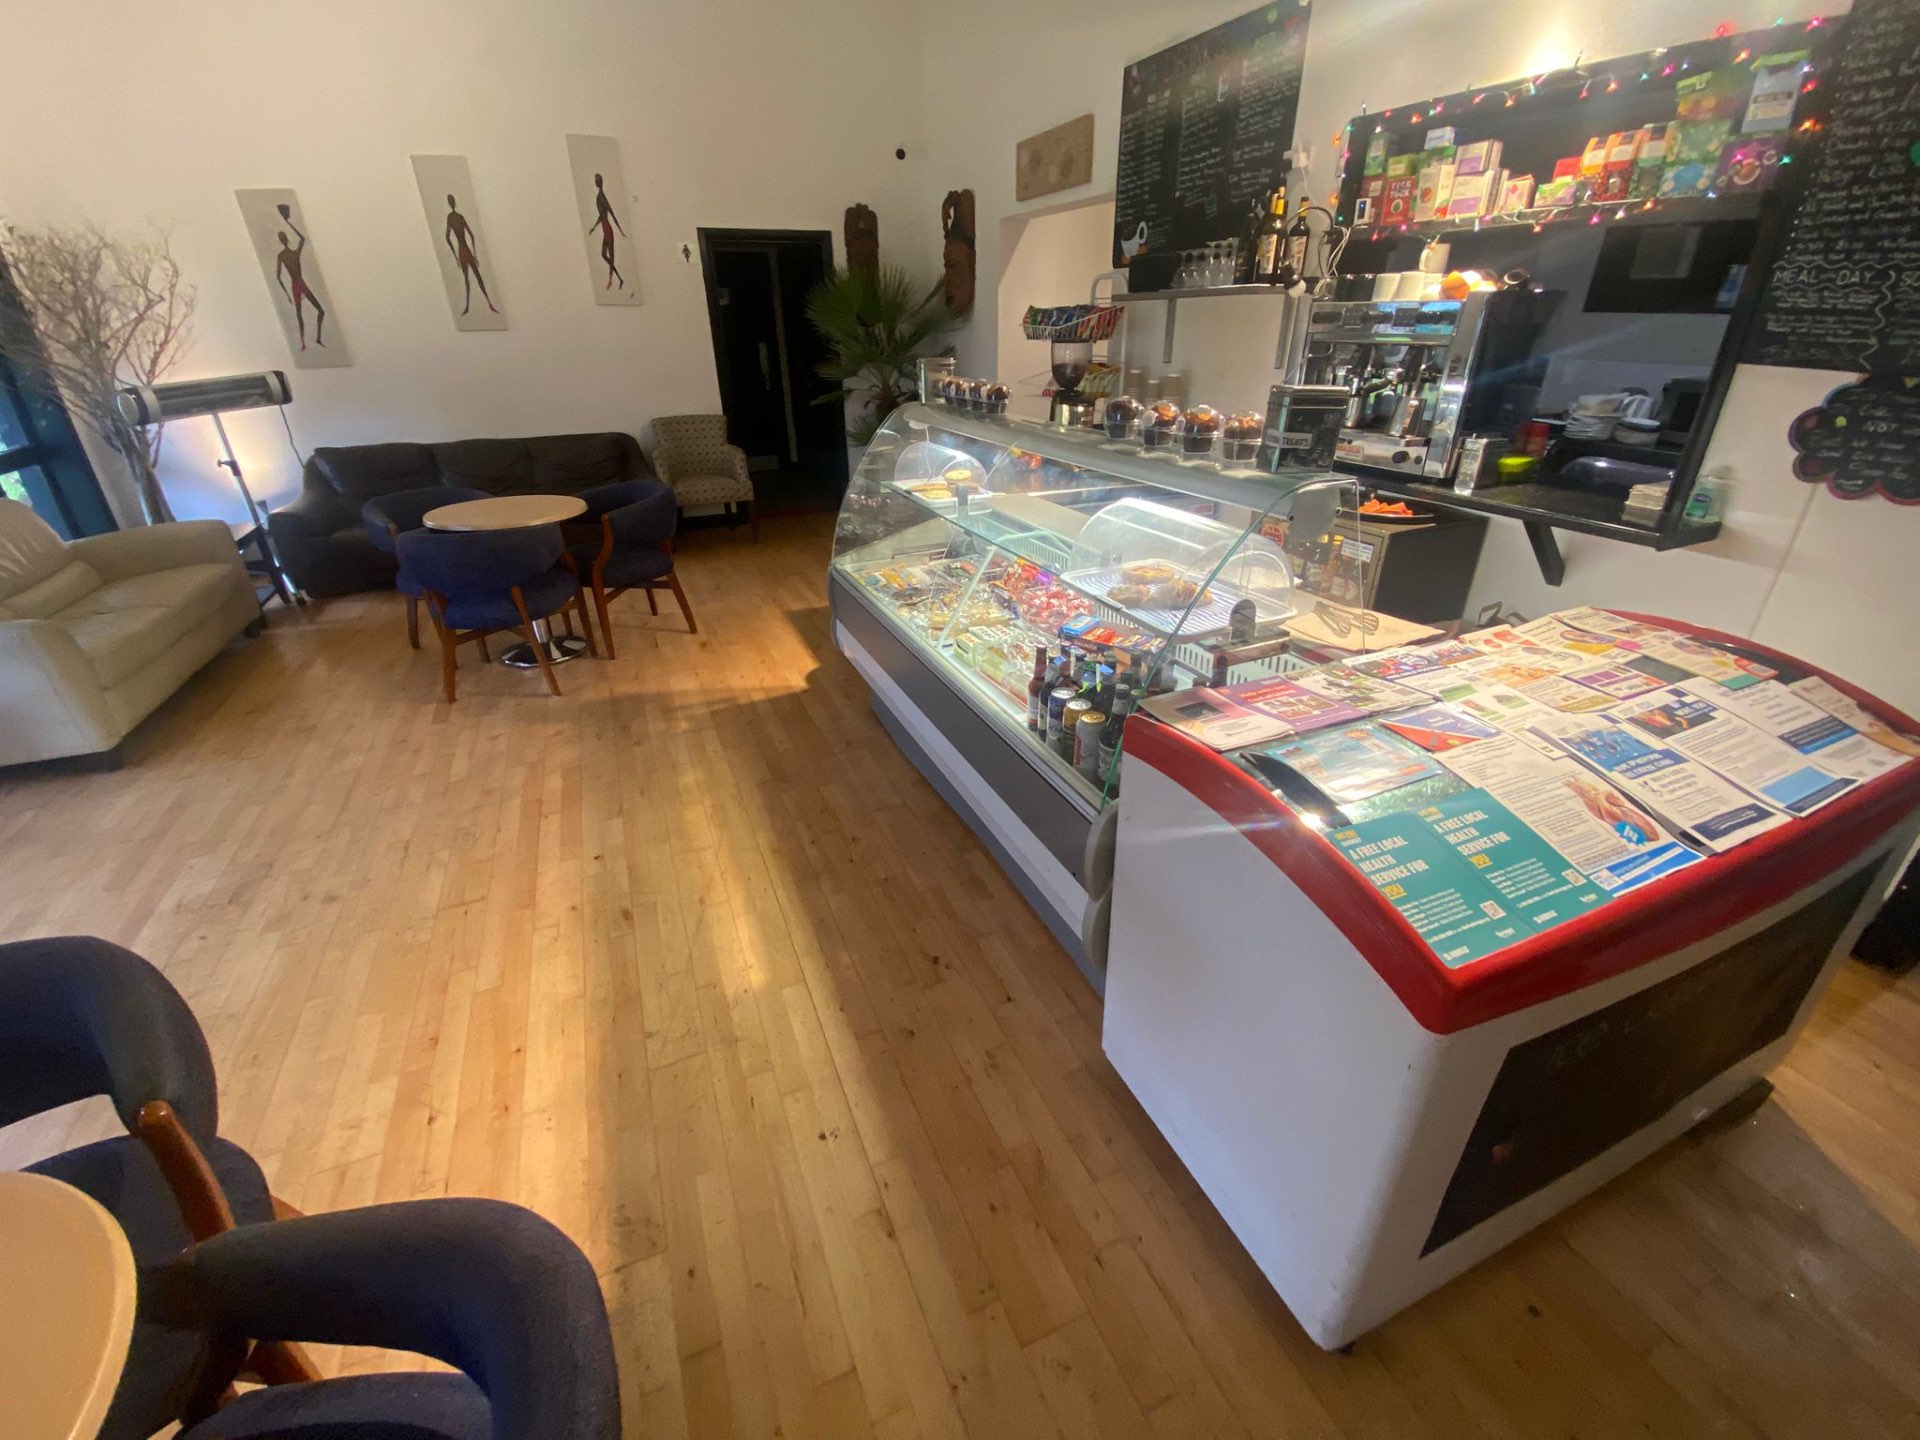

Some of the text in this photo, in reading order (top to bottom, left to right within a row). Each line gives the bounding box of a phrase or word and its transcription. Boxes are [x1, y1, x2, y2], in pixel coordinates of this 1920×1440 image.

[1772, 269, 1818, 284] MEAL
[1836, 269, 1874, 285] DAY
[1433, 823, 1445, 834] A
[1439, 817, 1464, 831] FREE
[1459, 810, 1489, 824] LOCAL
[1348, 849, 1360, 860] A
[1356, 841, 1381, 858] FREE
[1377, 835, 1408, 851] LOCAL
[1444, 827, 1480, 845] HEALTH
[1456, 831, 1511, 856] SERVICE FOR
[1359, 854, 1397, 873] HEALTH
[1370, 859, 1430, 886] SERVICE FOR
